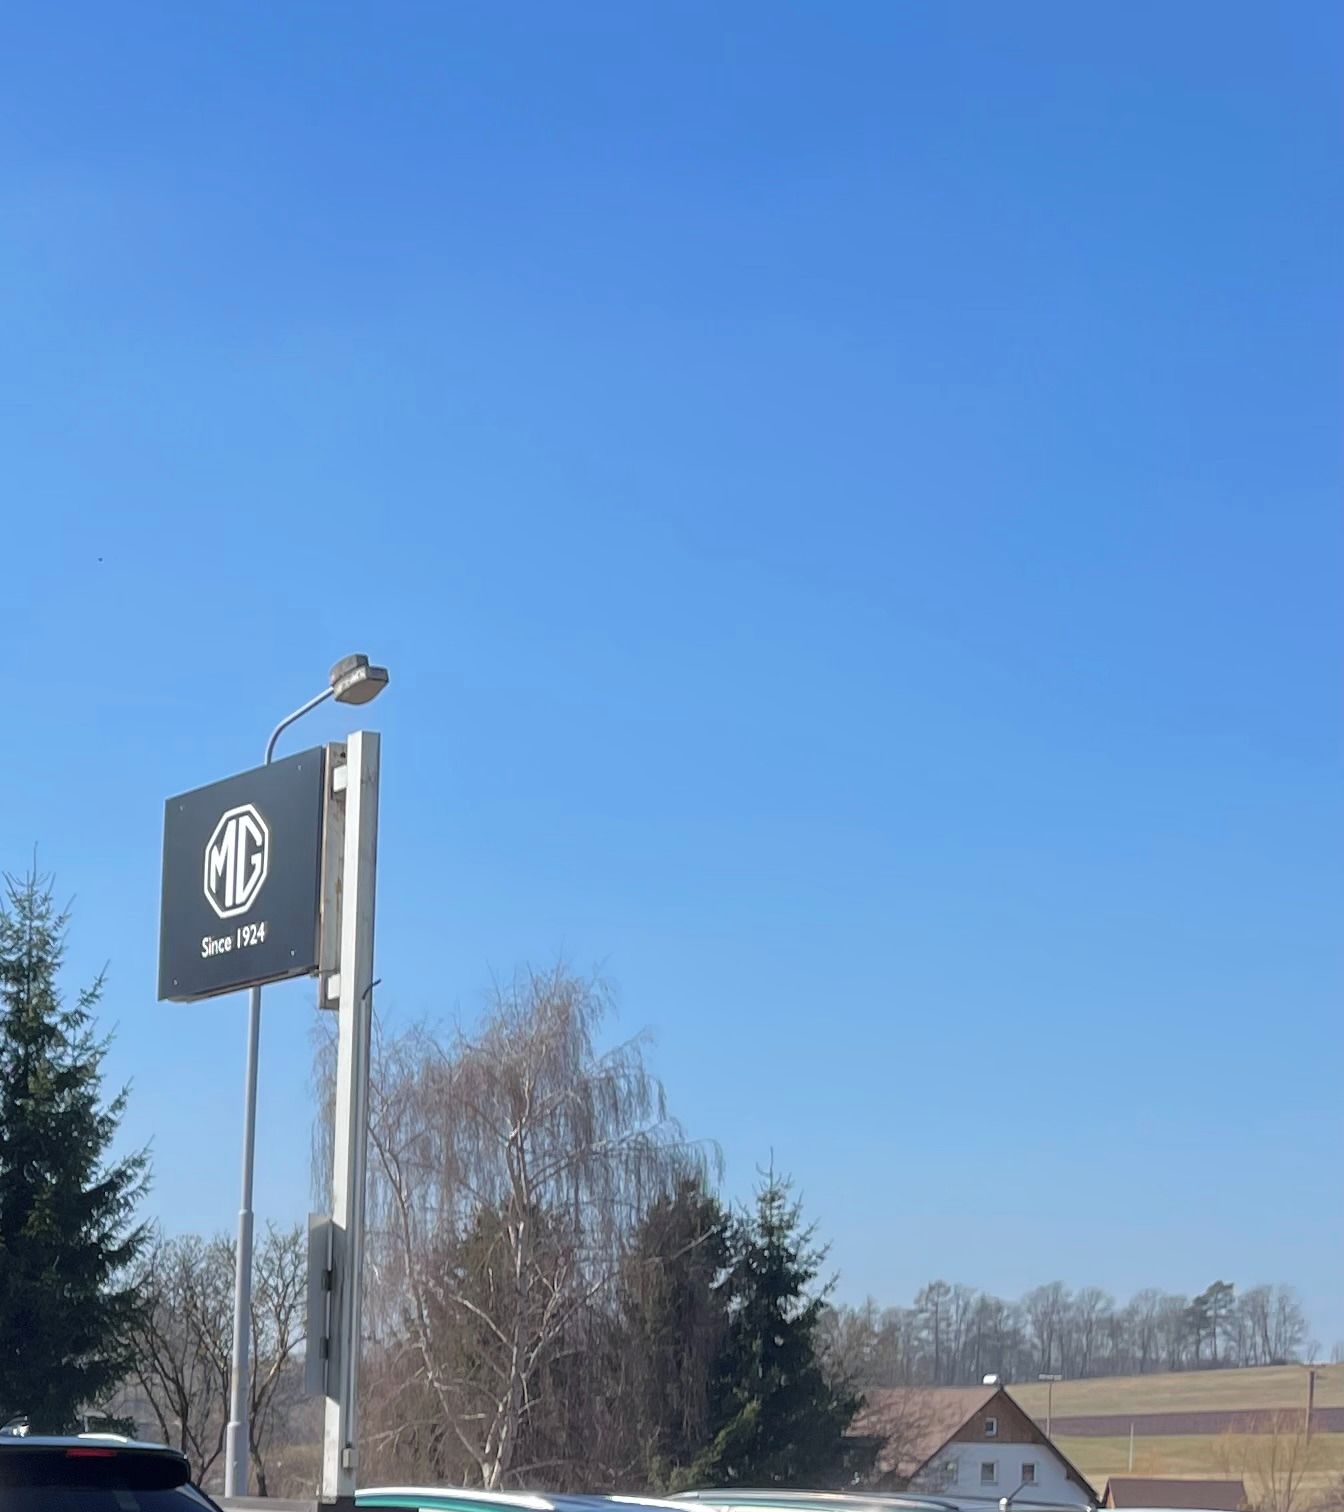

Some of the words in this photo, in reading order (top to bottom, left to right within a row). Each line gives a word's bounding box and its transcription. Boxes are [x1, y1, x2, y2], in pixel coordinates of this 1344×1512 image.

[210, 814, 263, 907] MG
[201, 935, 232, 959] Since
[236, 921, 266, 948] 1924
